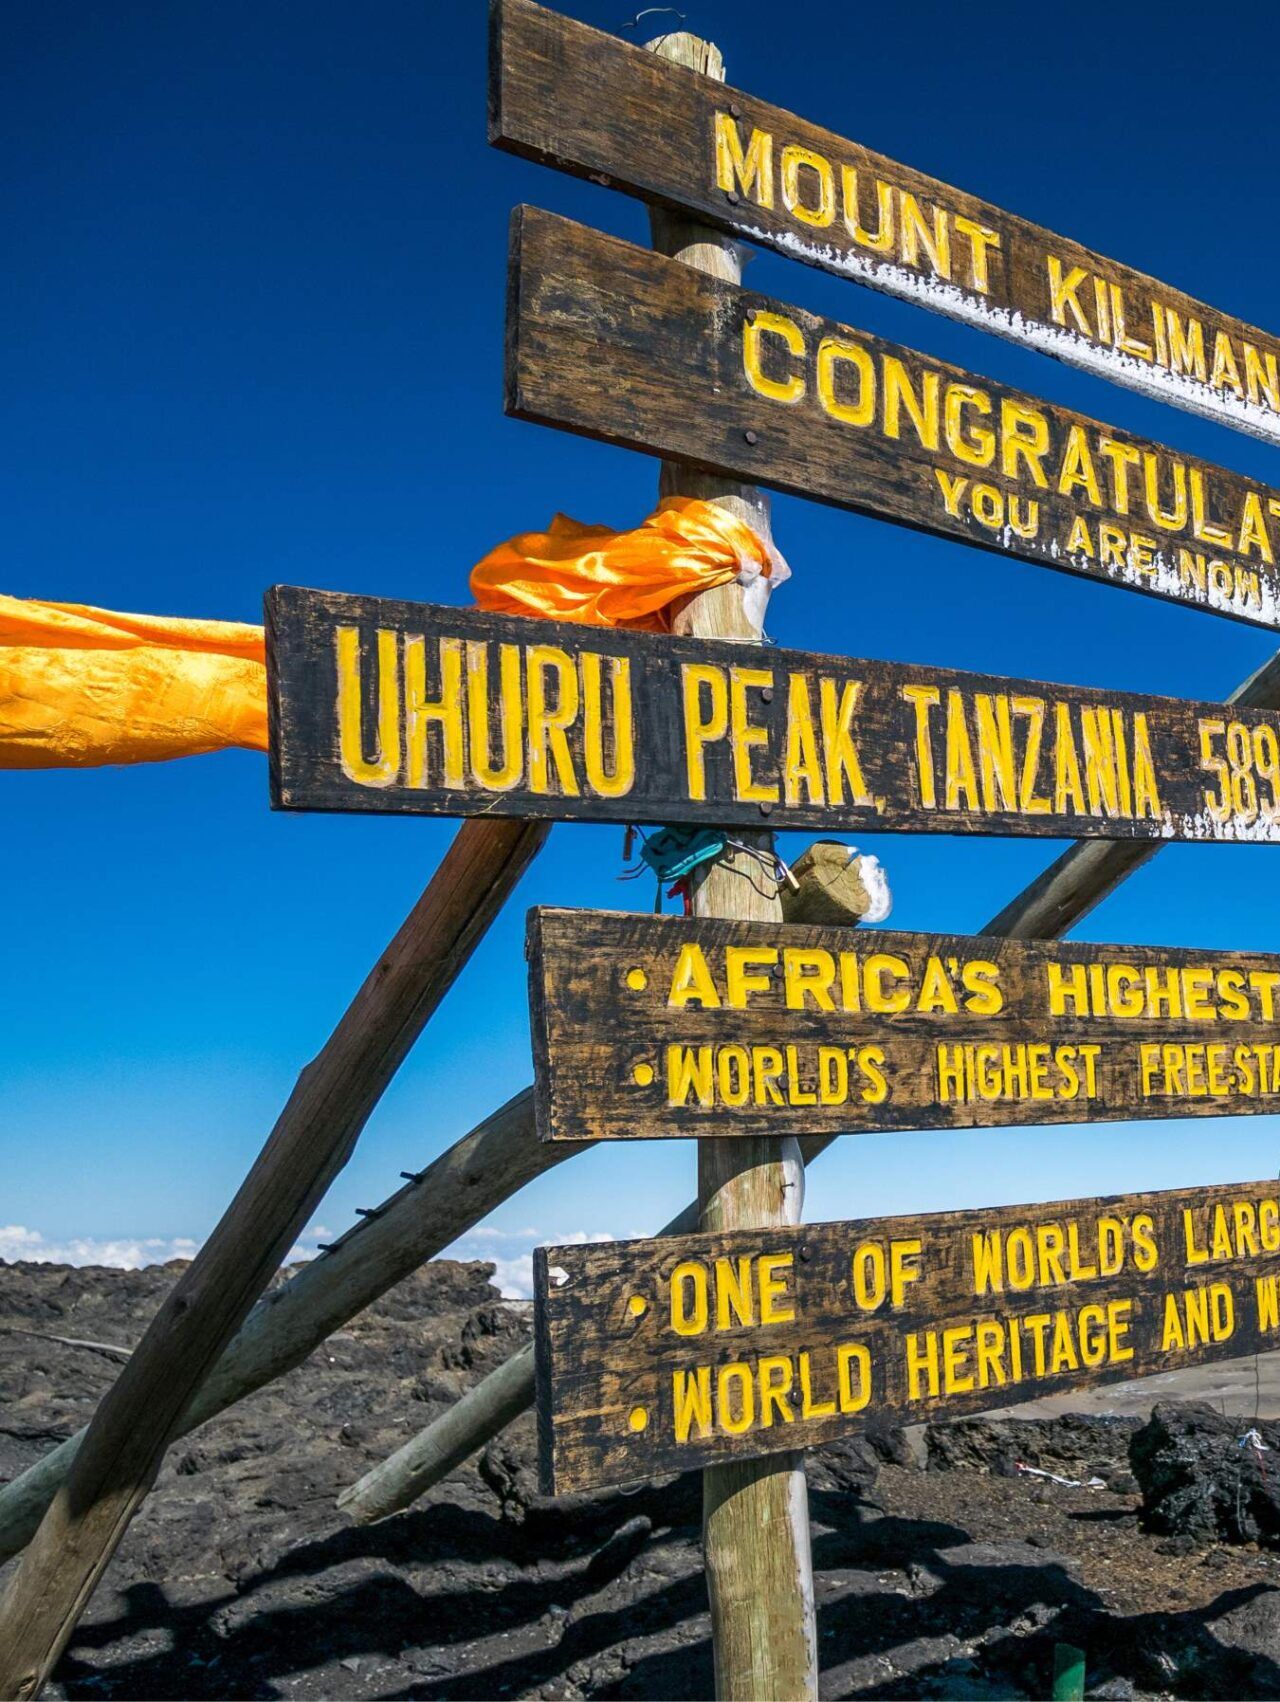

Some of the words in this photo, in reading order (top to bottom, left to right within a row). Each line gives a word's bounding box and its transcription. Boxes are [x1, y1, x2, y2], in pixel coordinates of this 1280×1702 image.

[713, 110, 1001, 295] MOUNT
[933, 467, 1040, 537] YOU
[1066, 515, 1160, 578] ARE
[335, 625, 637, 799] UHURU
[667, 942, 1005, 1019] AFRICA'S
[664, 1042, 889, 1110] WORLD'S
[936, 1041, 1103, 1105] HIGHEST
[668, 1252, 797, 1337] ONE
[851, 1239, 924, 1312] OF
[970, 1213, 1159, 1297] WORLD'S
[671, 1341, 873, 1445] WORLD
[905, 1298, 1135, 1402] HERITAGE
[1160, 1280, 1235, 1353] AND
